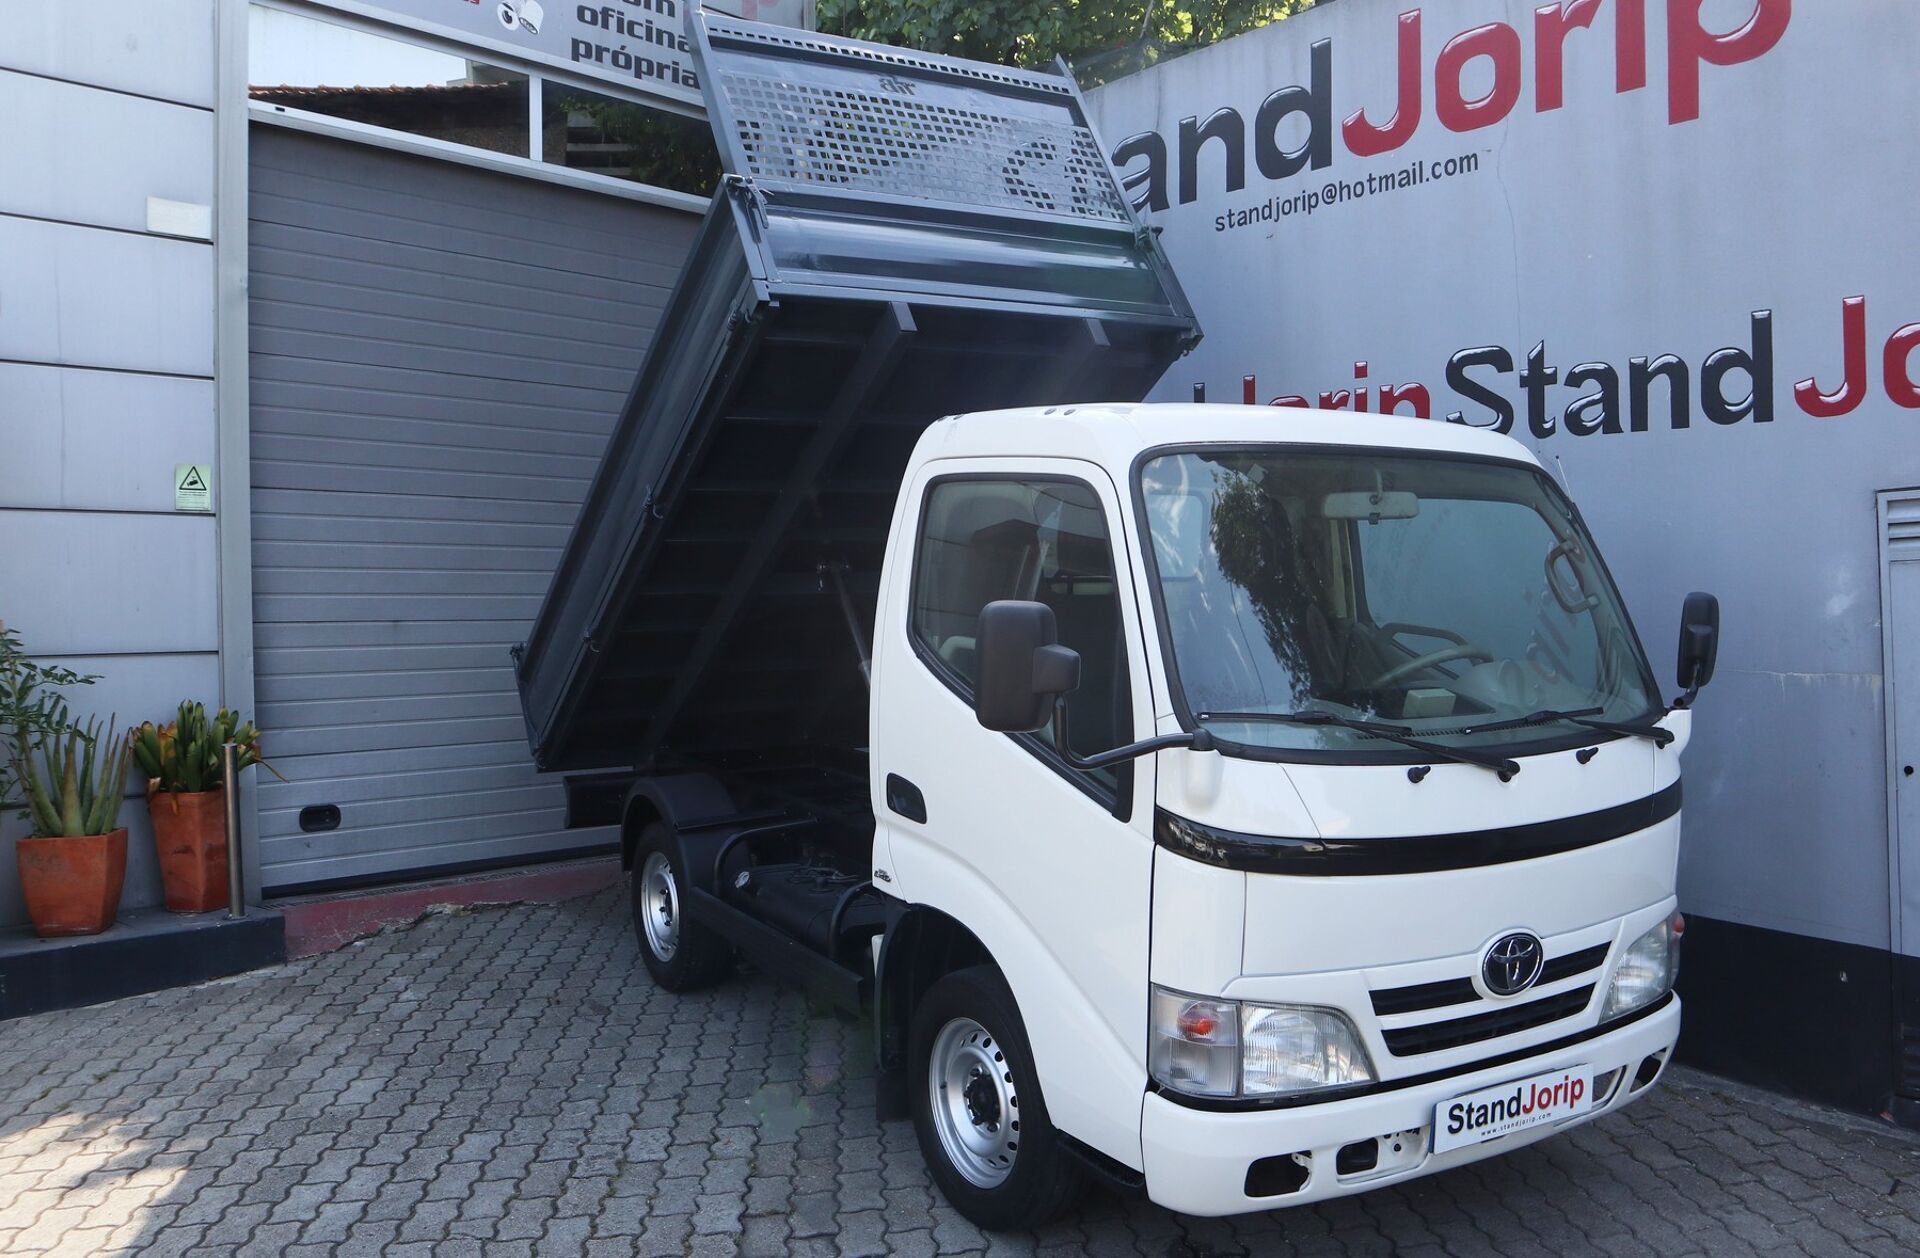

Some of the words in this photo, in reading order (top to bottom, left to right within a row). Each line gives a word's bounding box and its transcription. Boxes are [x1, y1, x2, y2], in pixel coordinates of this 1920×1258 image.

[577, 5, 693, 53] oficina
[571, 37, 700, 90] própria
[1002, 0, 1791, 214] andJorip
[1215, 153, 1479, 232] standjorip@hotmail.com
[1447, 1074, 1585, 1134] StandJorip
[1481, 1112, 1552, 1137] www.standjorip.com
